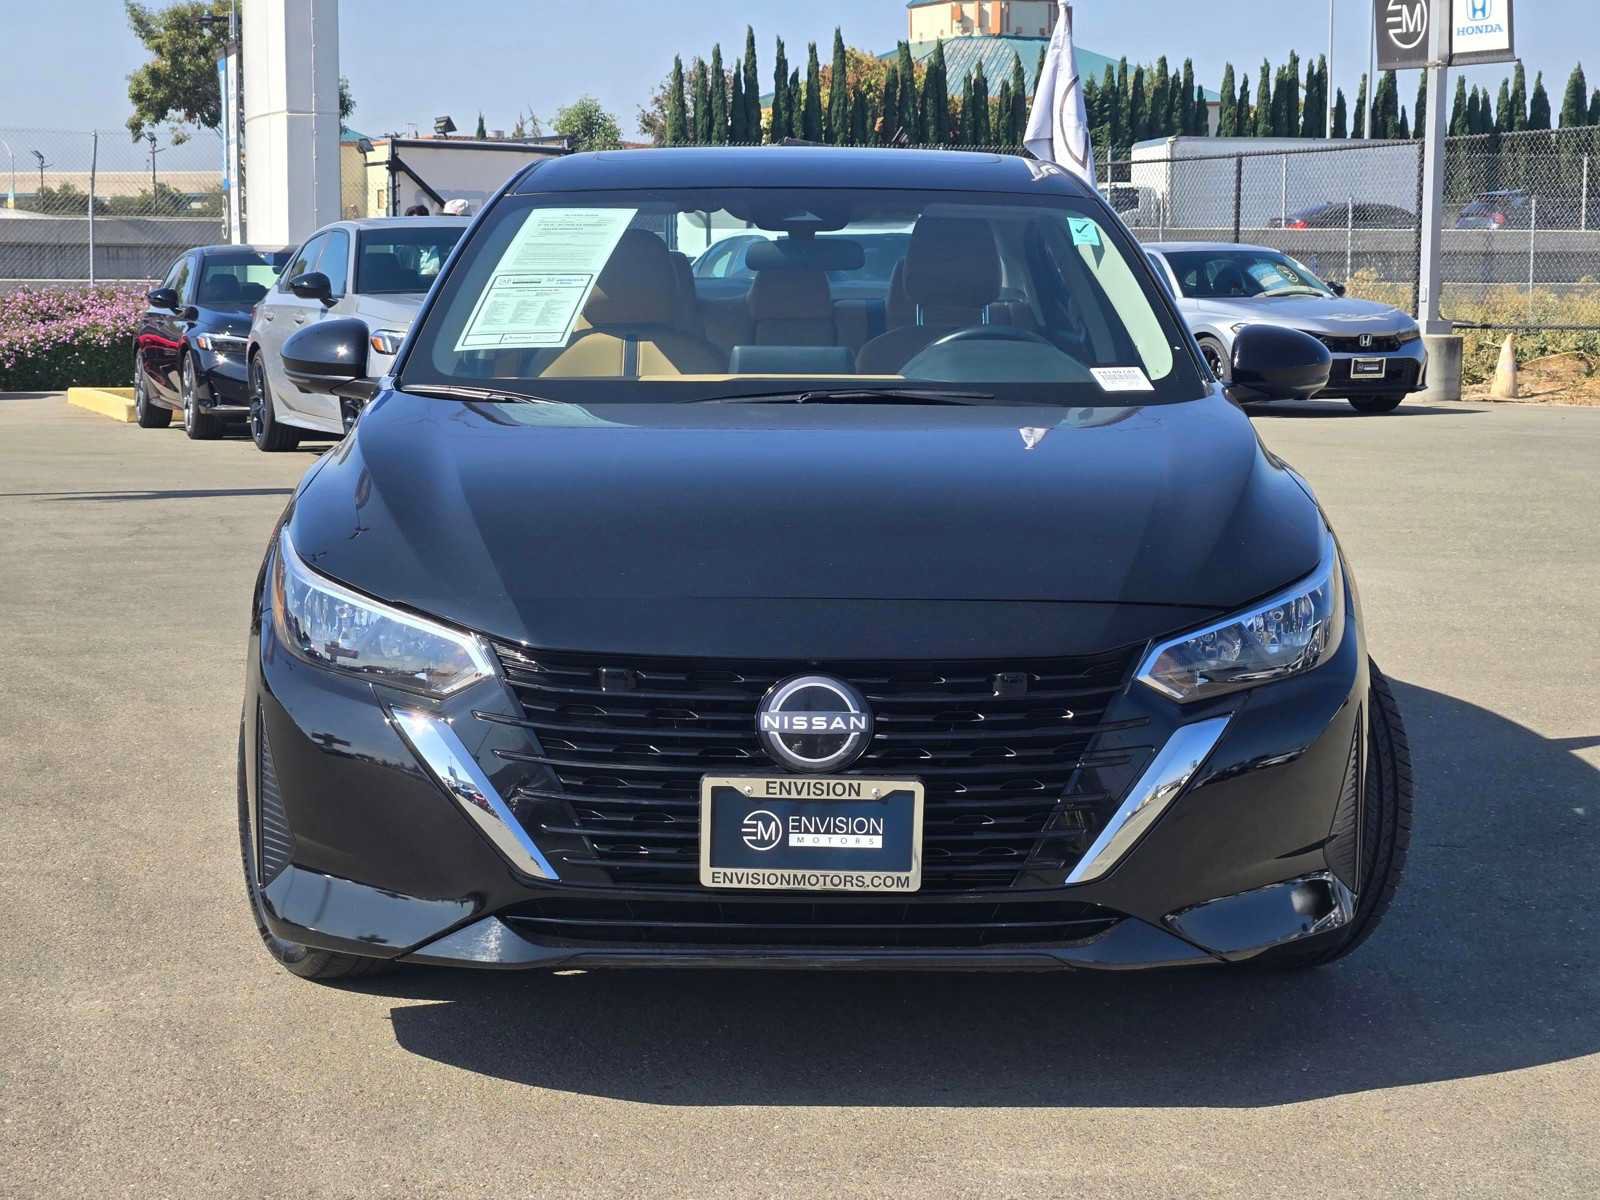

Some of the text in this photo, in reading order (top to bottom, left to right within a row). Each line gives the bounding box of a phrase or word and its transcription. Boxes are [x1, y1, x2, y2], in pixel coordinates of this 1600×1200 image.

[1456, 23, 1504, 37] HONDA
[763, 715, 866, 730] NISSAN
[765, 780, 861, 797] ENVISION
[788, 815, 884, 835] ENVISION
[796, 836, 875, 846] MOTORS
[711, 871, 910, 889] ENVISIONMOTORS.COM
